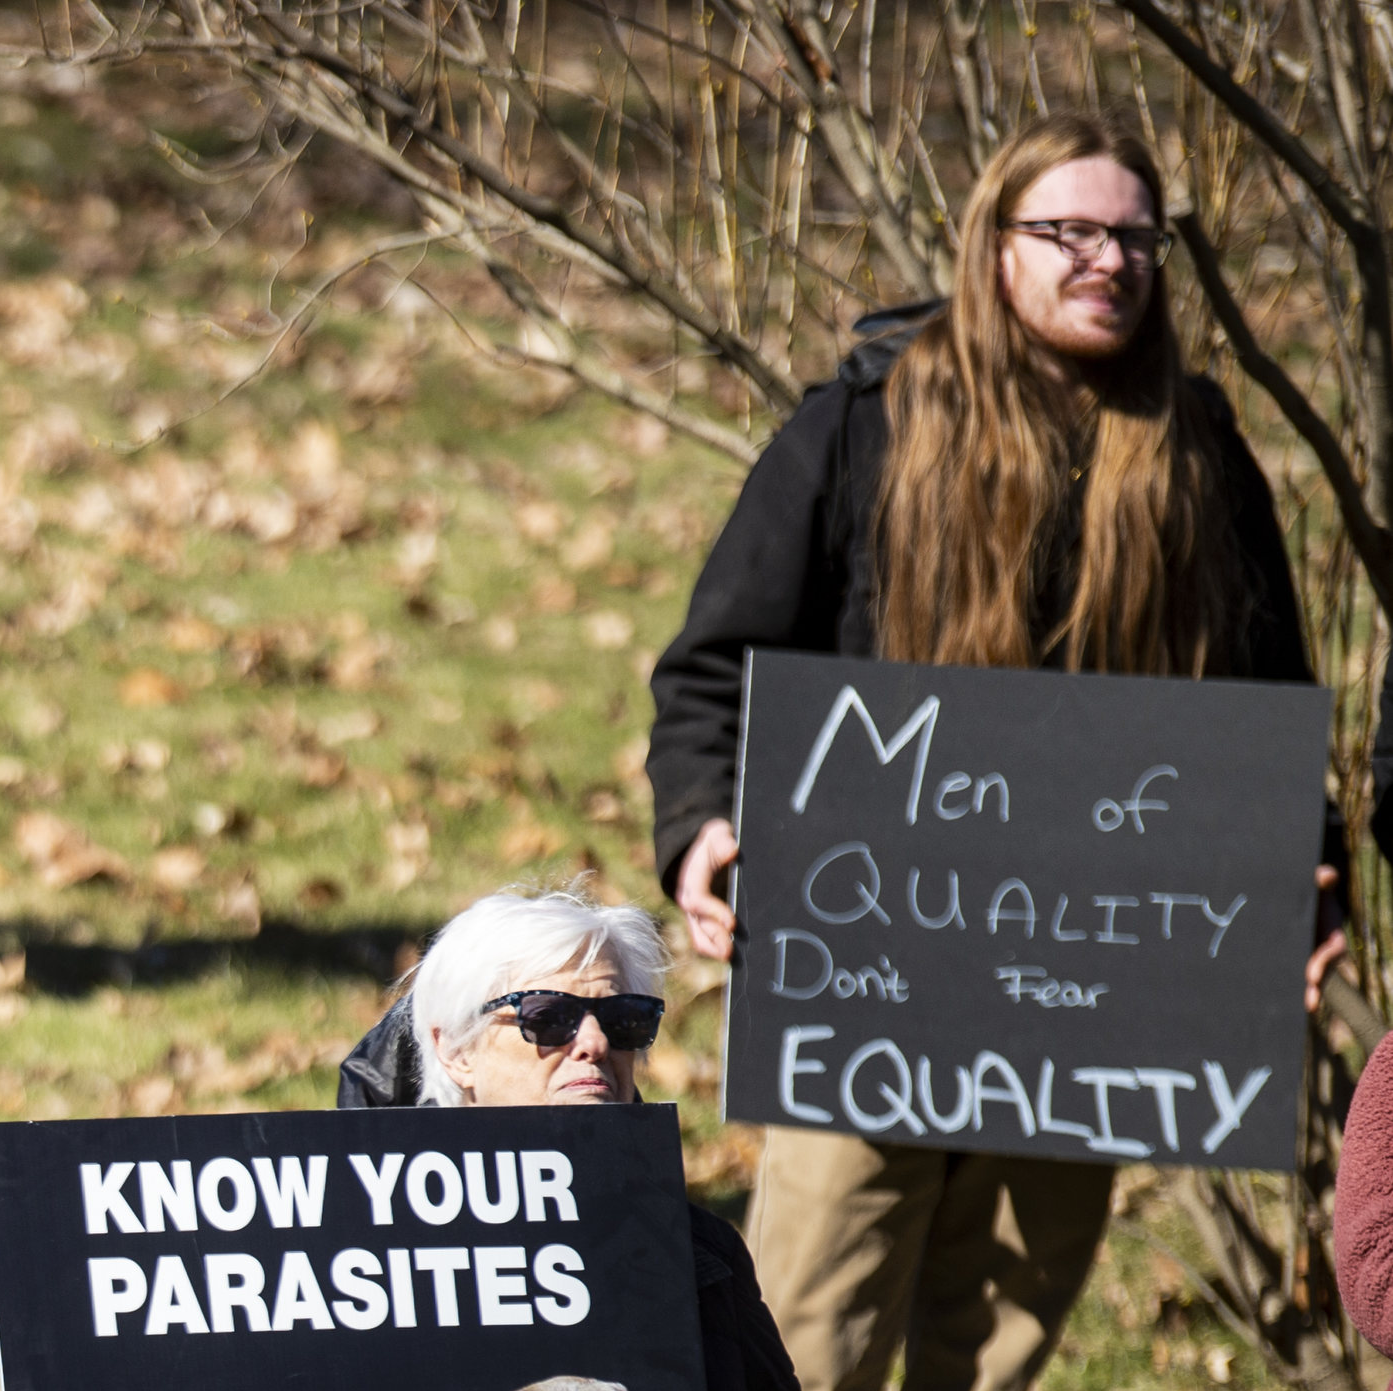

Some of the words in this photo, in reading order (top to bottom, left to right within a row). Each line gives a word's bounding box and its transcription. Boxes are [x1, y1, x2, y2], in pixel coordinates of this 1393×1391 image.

[791, 684, 1010, 826] Men
[1091, 763, 1179, 834] of
[803, 840, 1248, 959] QUALITY
[768, 928, 910, 1004] Don't
[992, 964, 1111, 1010] Fear
[778, 1025, 1273, 1157] EQUALITY
[79, 1154, 329, 1235] KNOW
[348, 1150, 580, 1226] YOUR
[88, 1244, 591, 1337] PARASITES
